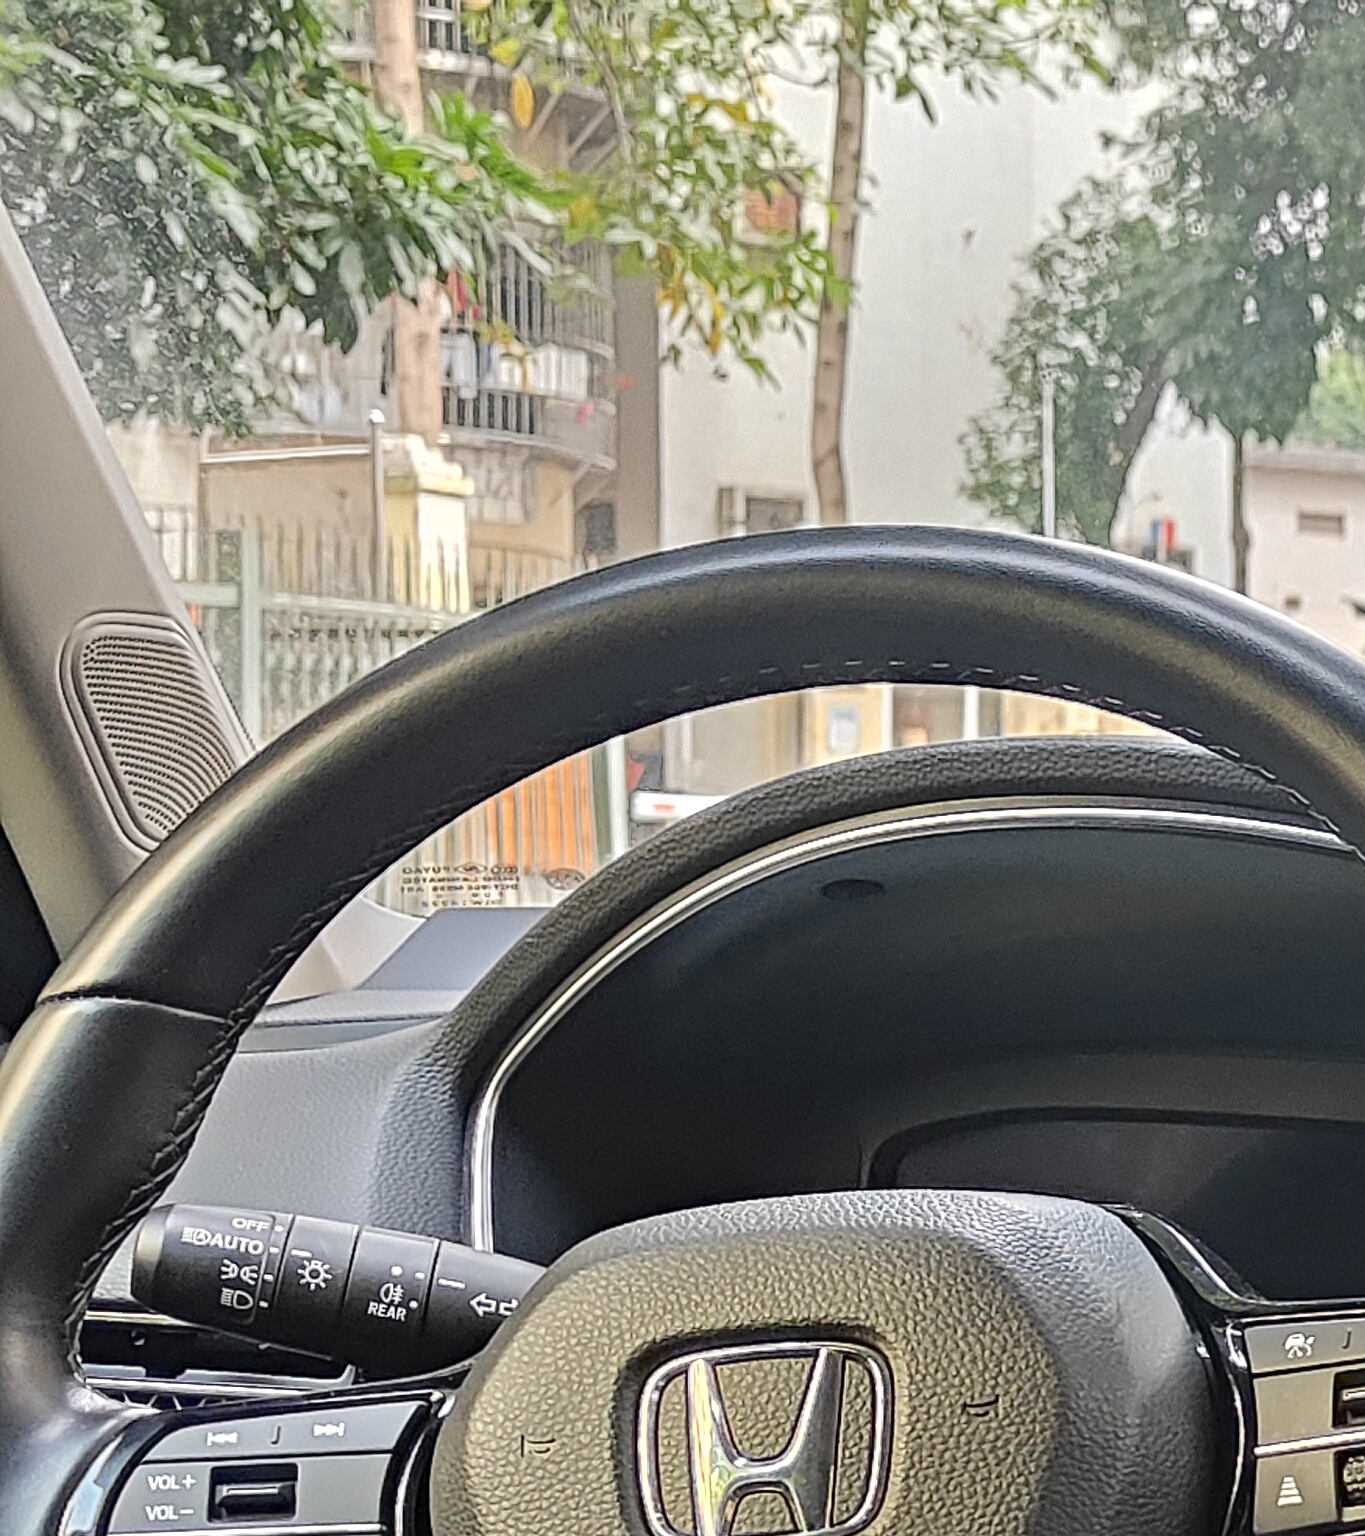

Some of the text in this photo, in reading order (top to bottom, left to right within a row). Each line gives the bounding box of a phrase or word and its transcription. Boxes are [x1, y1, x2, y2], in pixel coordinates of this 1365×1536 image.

[231, 1217, 271, 1232] OFF
[209, 1232, 265, 1256] AUTO
[366, 1300, 407, 1322] REAR
